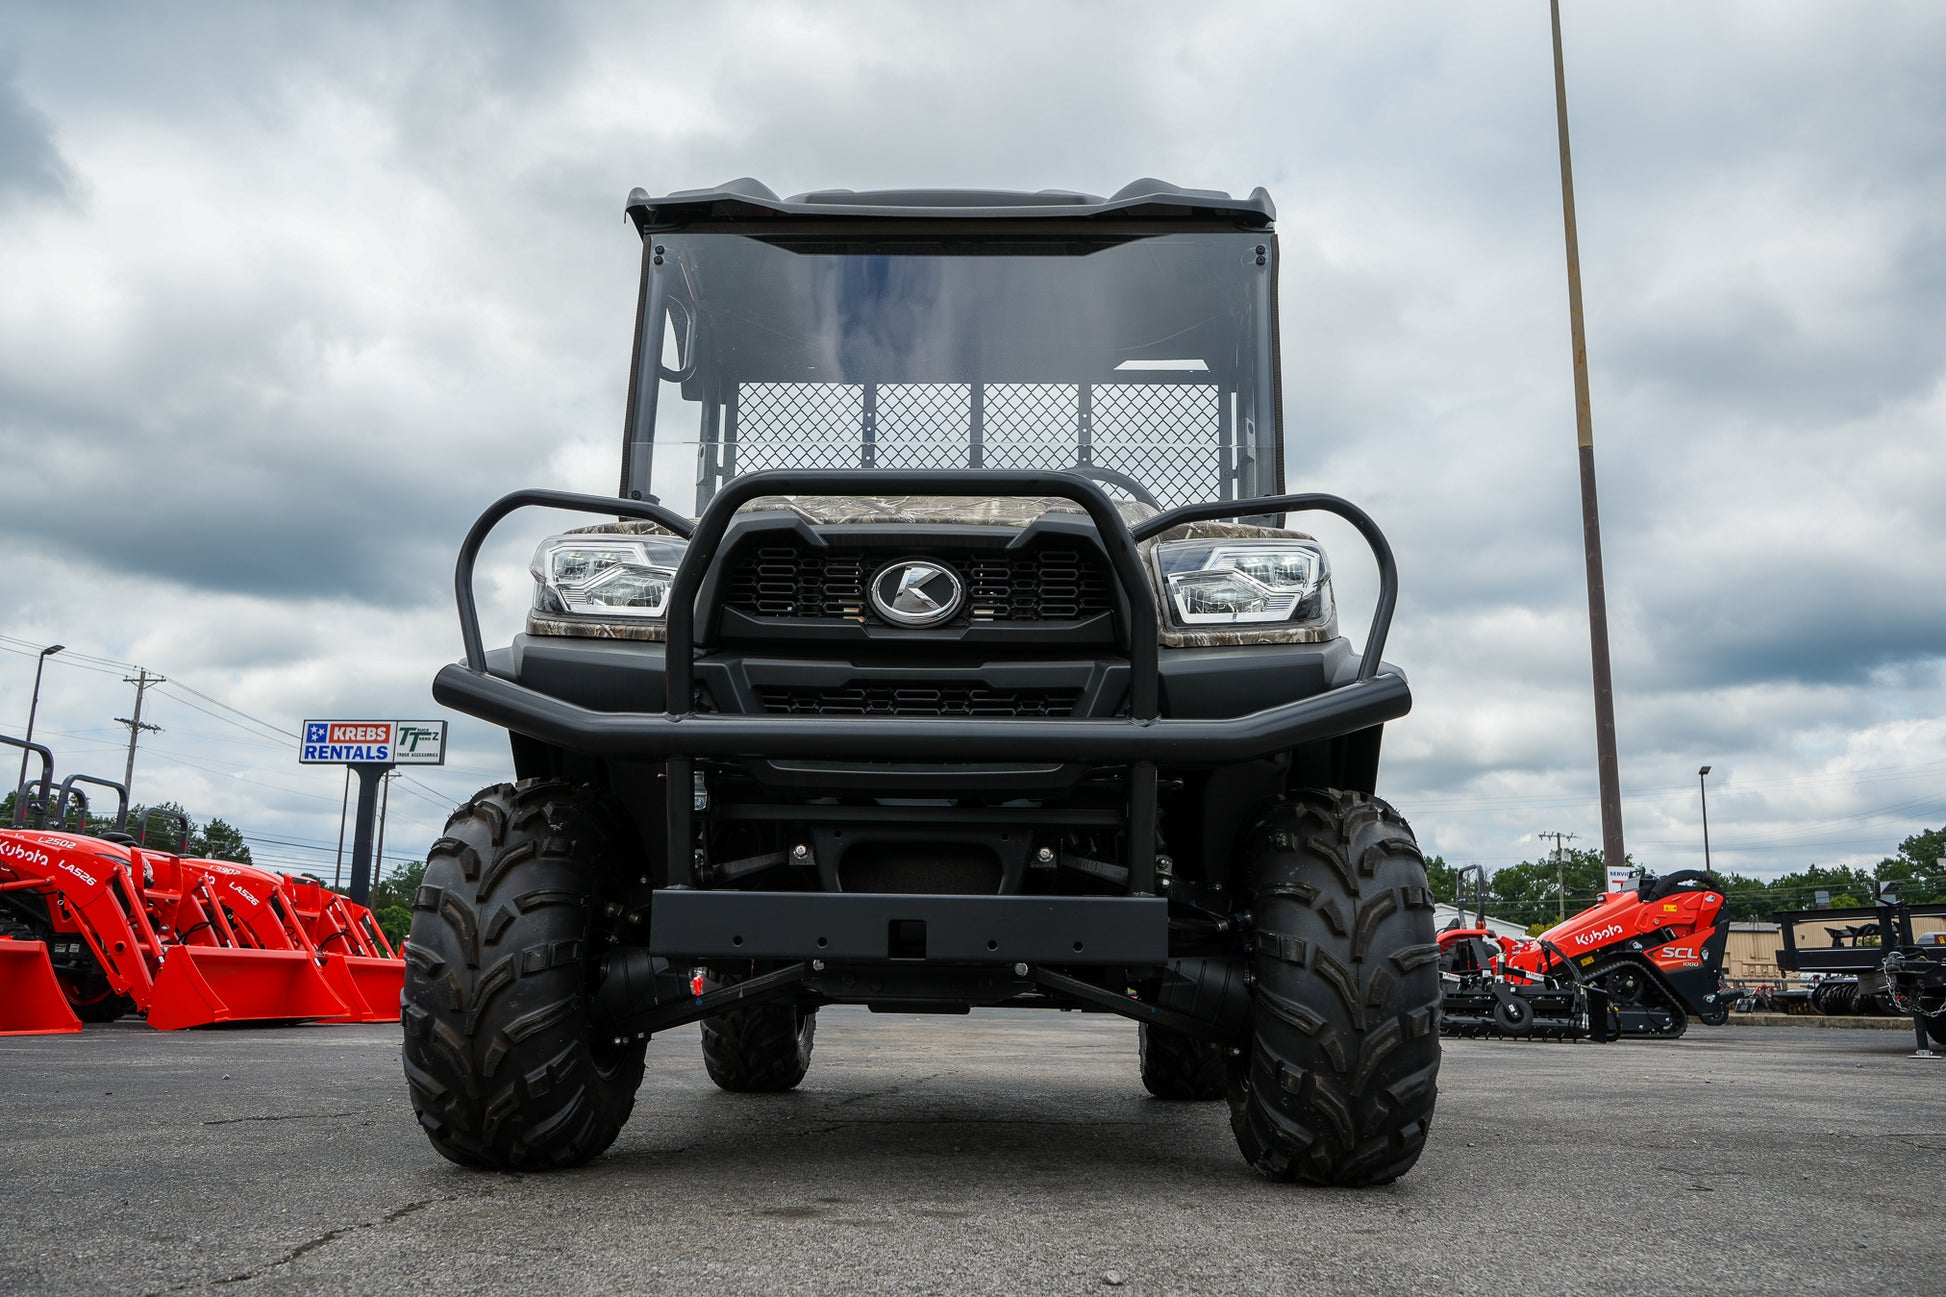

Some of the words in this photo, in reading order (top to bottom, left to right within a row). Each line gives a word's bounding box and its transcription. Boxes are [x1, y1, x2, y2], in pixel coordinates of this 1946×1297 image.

[333, 726, 387, 741] KREBS
[304, 745, 389, 760] RENTALS
[37, 836, 77, 849] L2502
[58, 859, 97, 886] LA526
[229, 881, 260, 906] LA526
[1575, 924, 1623, 945] Kubota
[1661, 947, 1699, 959] SCL
